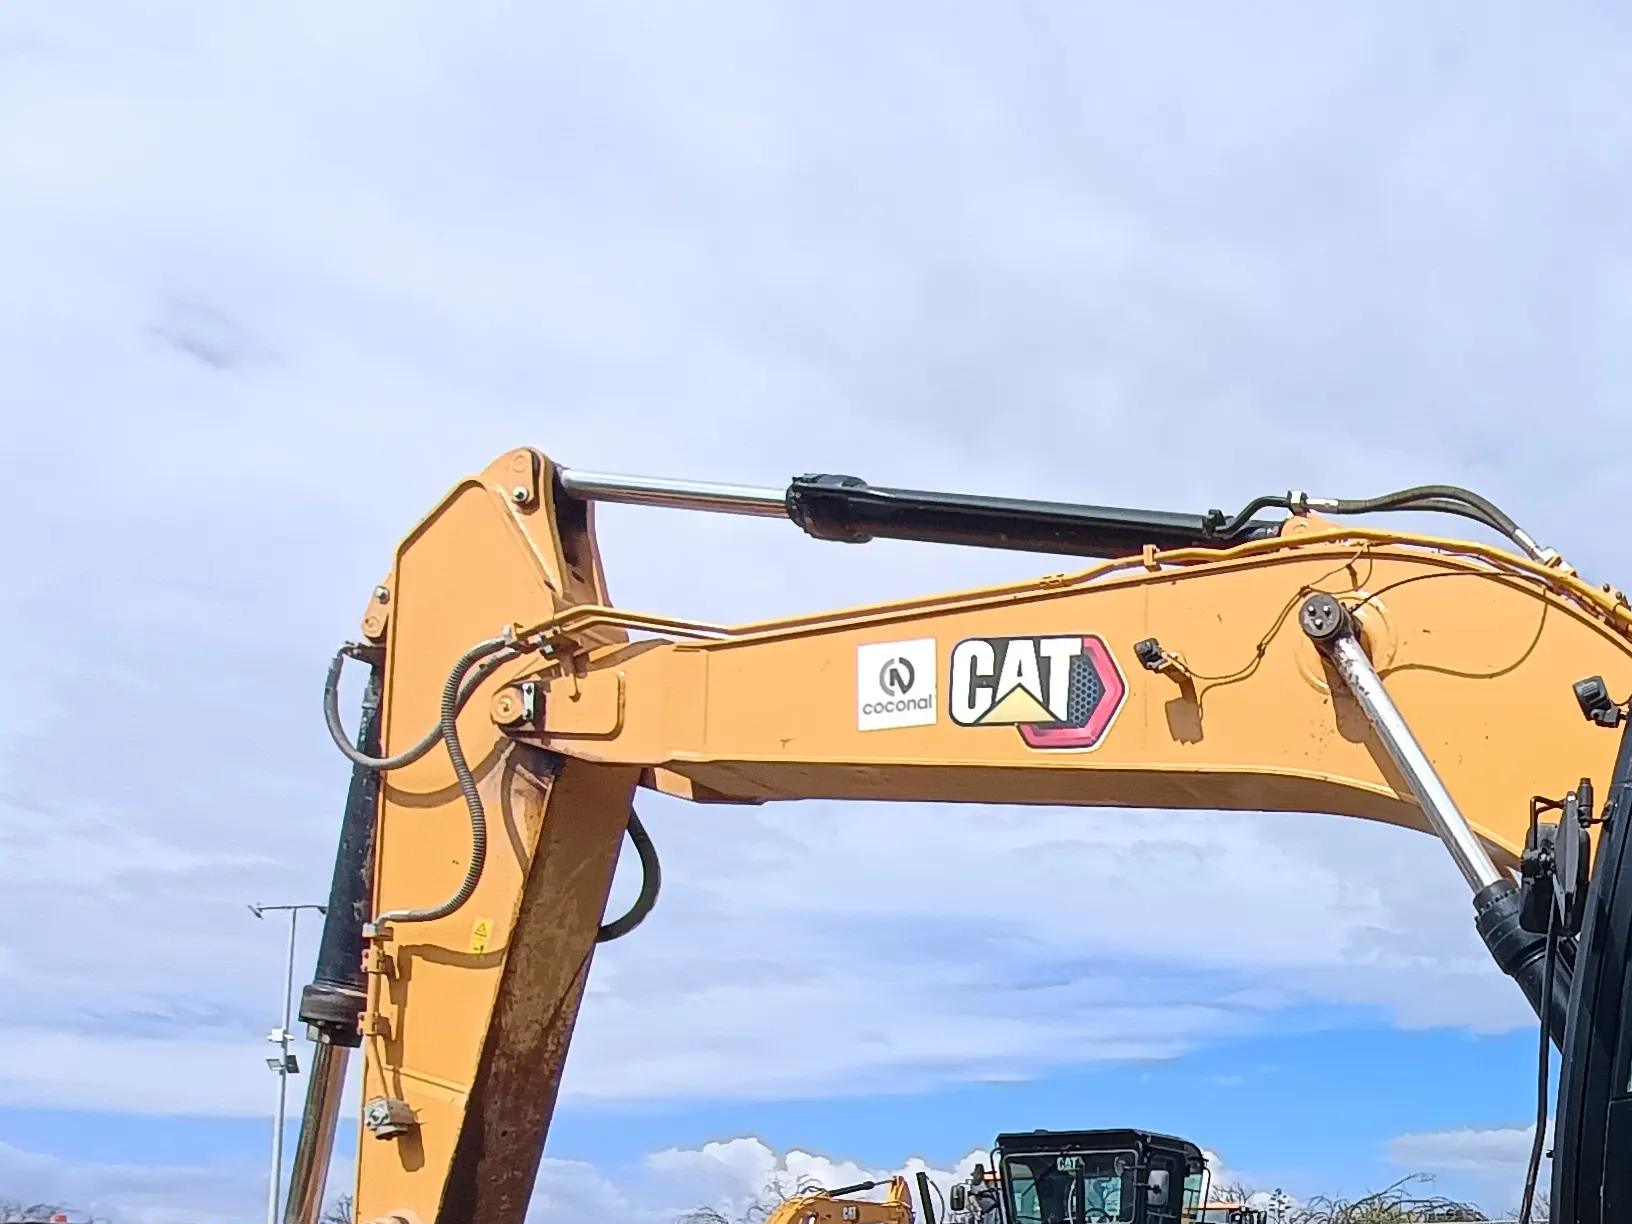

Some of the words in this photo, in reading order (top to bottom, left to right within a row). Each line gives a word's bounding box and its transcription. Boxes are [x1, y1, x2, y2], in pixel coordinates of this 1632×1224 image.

[951, 637, 1082, 724] CAT
[862, 694, 932, 715] coconal
[1057, 1156, 1078, 1171] CAT
